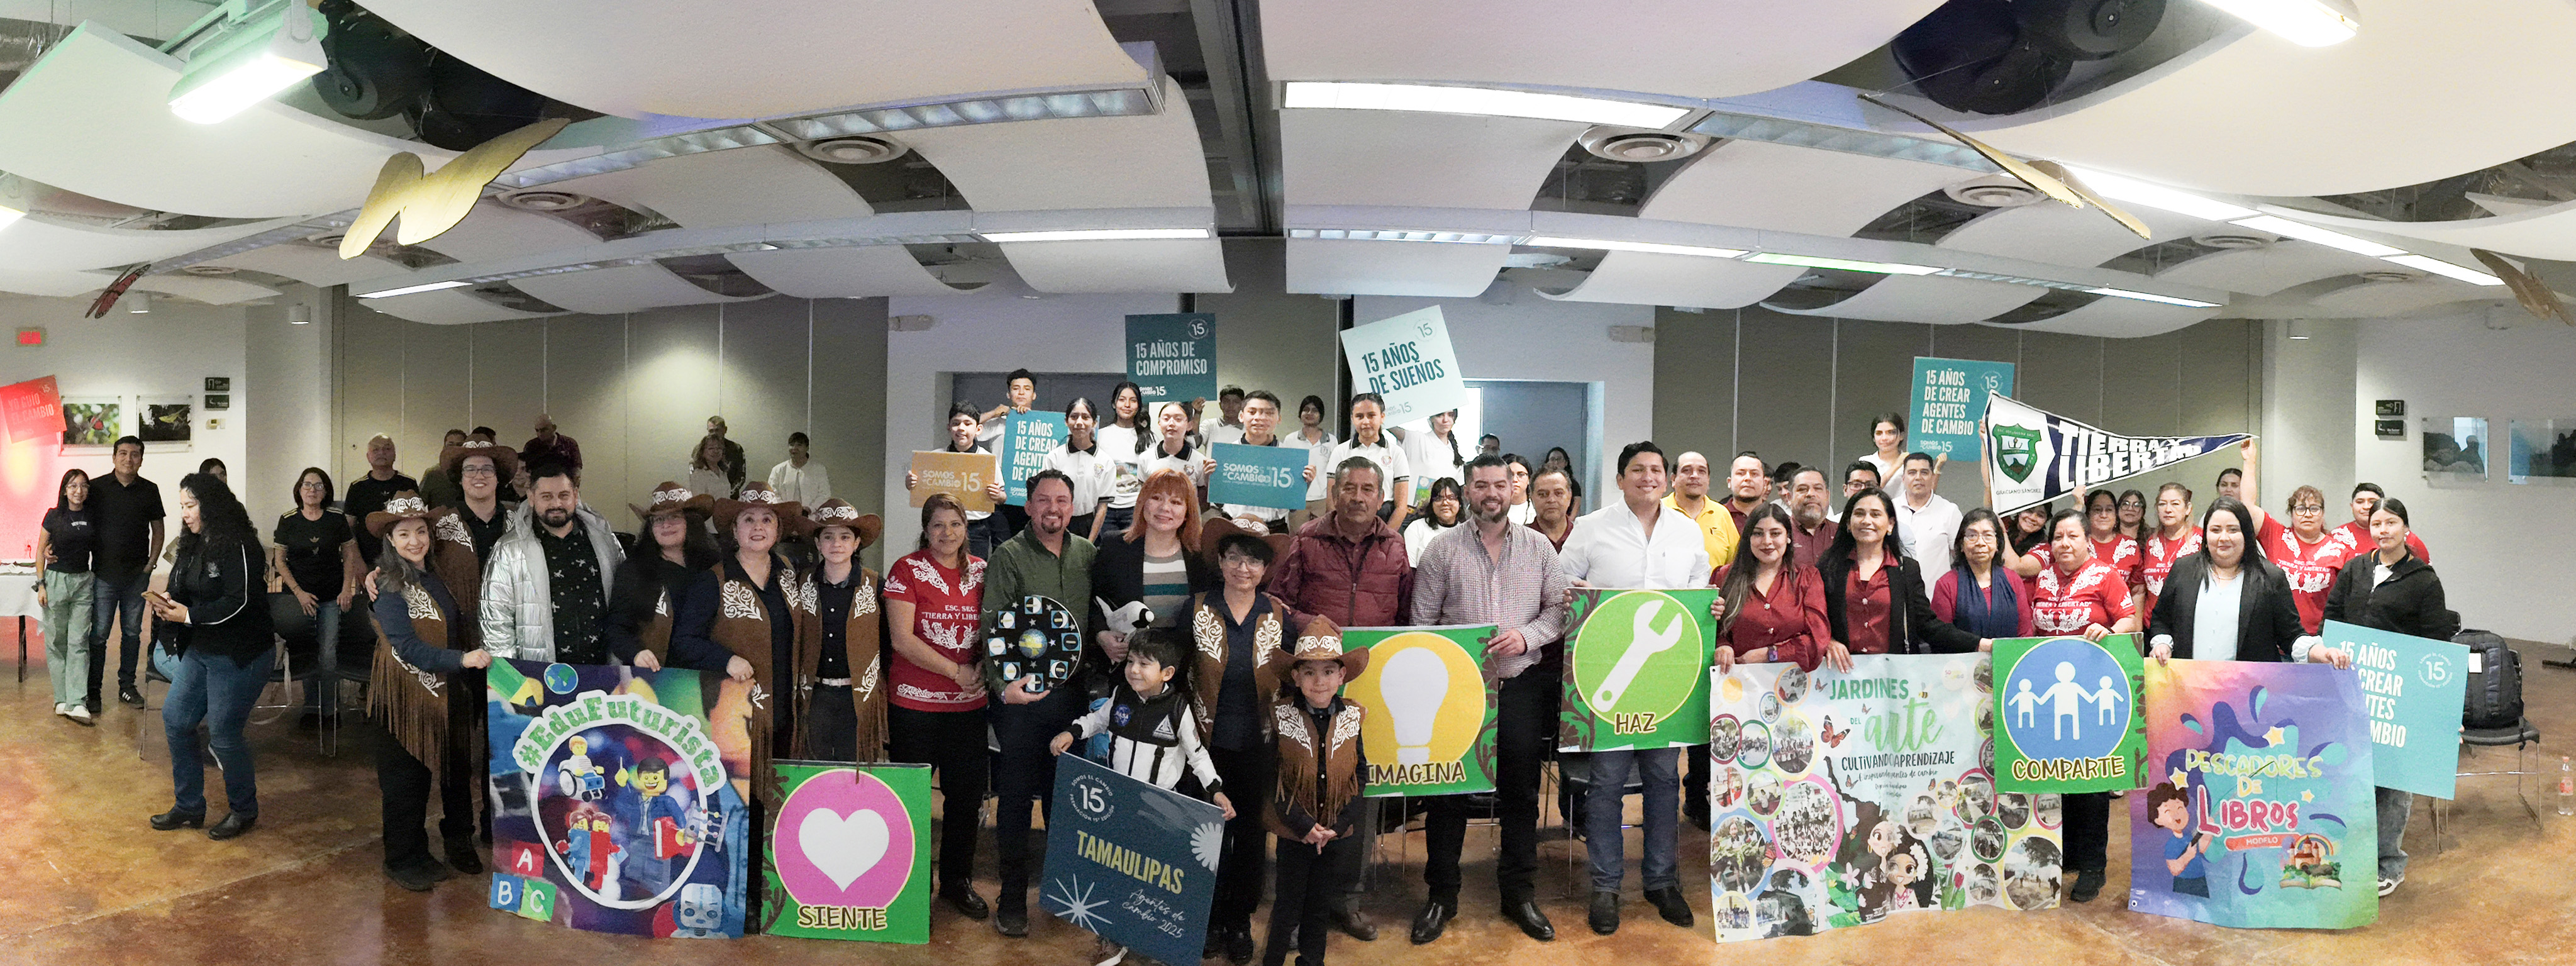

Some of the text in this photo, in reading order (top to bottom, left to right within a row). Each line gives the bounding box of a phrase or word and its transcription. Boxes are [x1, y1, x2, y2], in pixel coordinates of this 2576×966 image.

[1192, 323, 1205, 335] 15
[1418, 323, 1433, 338] 15
[1135, 340, 1195, 358] 15 AÑOS DE
[1362, 341, 1419, 374] 15 AÑOS
[1136, 358, 1208, 376] COMPROMISO
[1368, 358, 1445, 394] DE SUEÑOS
[1926, 370, 1937, 385] 15
[1938, 368, 1965, 386] AÑOS
[1156, 386, 1167, 396] 15
[1985, 375, 1999, 389] 15
[1924, 386, 1938, 401] DE
[1939, 387, 1970, 402] CREAR
[23, 404, 54, 421] CAMBIO
[1399, 402, 1413, 414] 15
[1923, 402, 1966, 419] AGENTES
[1017, 419, 1053, 437] 15 AÑOS
[1922, 419, 1974, 435] DE CAMBIO
[1015, 436, 1058, 452] DE CREAR
[1942, 441, 1952, 452] 15
[2058, 419, 2161, 456] TIERRA
[922, 470, 955, 479] SOMOS
[1012, 466, 1024, 481] DE
[1271, 467, 1292, 488] 15
[2058, 444, 2202, 492] LIBERTAD
[926, 479, 961, 487] CAMBIO
[962, 472, 980, 492] 15
[2340, 641, 2397, 671] 15 AÑOS
[2426, 661, 2445, 680] 15
[1829, 678, 1909, 700] JARDINES
[2358, 669, 2403, 697] CREAR
[1616, 713, 1655, 733] HAZ
[1864, 697, 1943, 753] arte
[519, 696, 719, 788] #EduFuturista
[1366, 762, 1465, 784] IMAGINA
[2012, 757, 2124, 779] COMPARTE
[2186, 748, 2323, 780] PESCADORES
[1071, 774, 1087, 787] SOMOS
[1095, 777, 1113, 796] CAMBIO
[2237, 777, 2263, 797] DE
[1080, 784, 1106, 813] 15
[2197, 786, 2299, 836] LIBROS
[2246, 836, 2279, 846] MODELO
[516, 848, 533, 872] A
[1077, 830, 1185, 894] TAMAULIPAS
[497, 880, 545, 913] B C
[1130, 889, 1185, 921] Agentes de
[799, 906, 886, 929] SIENTE
[1158, 919, 1184, 938] 2025
